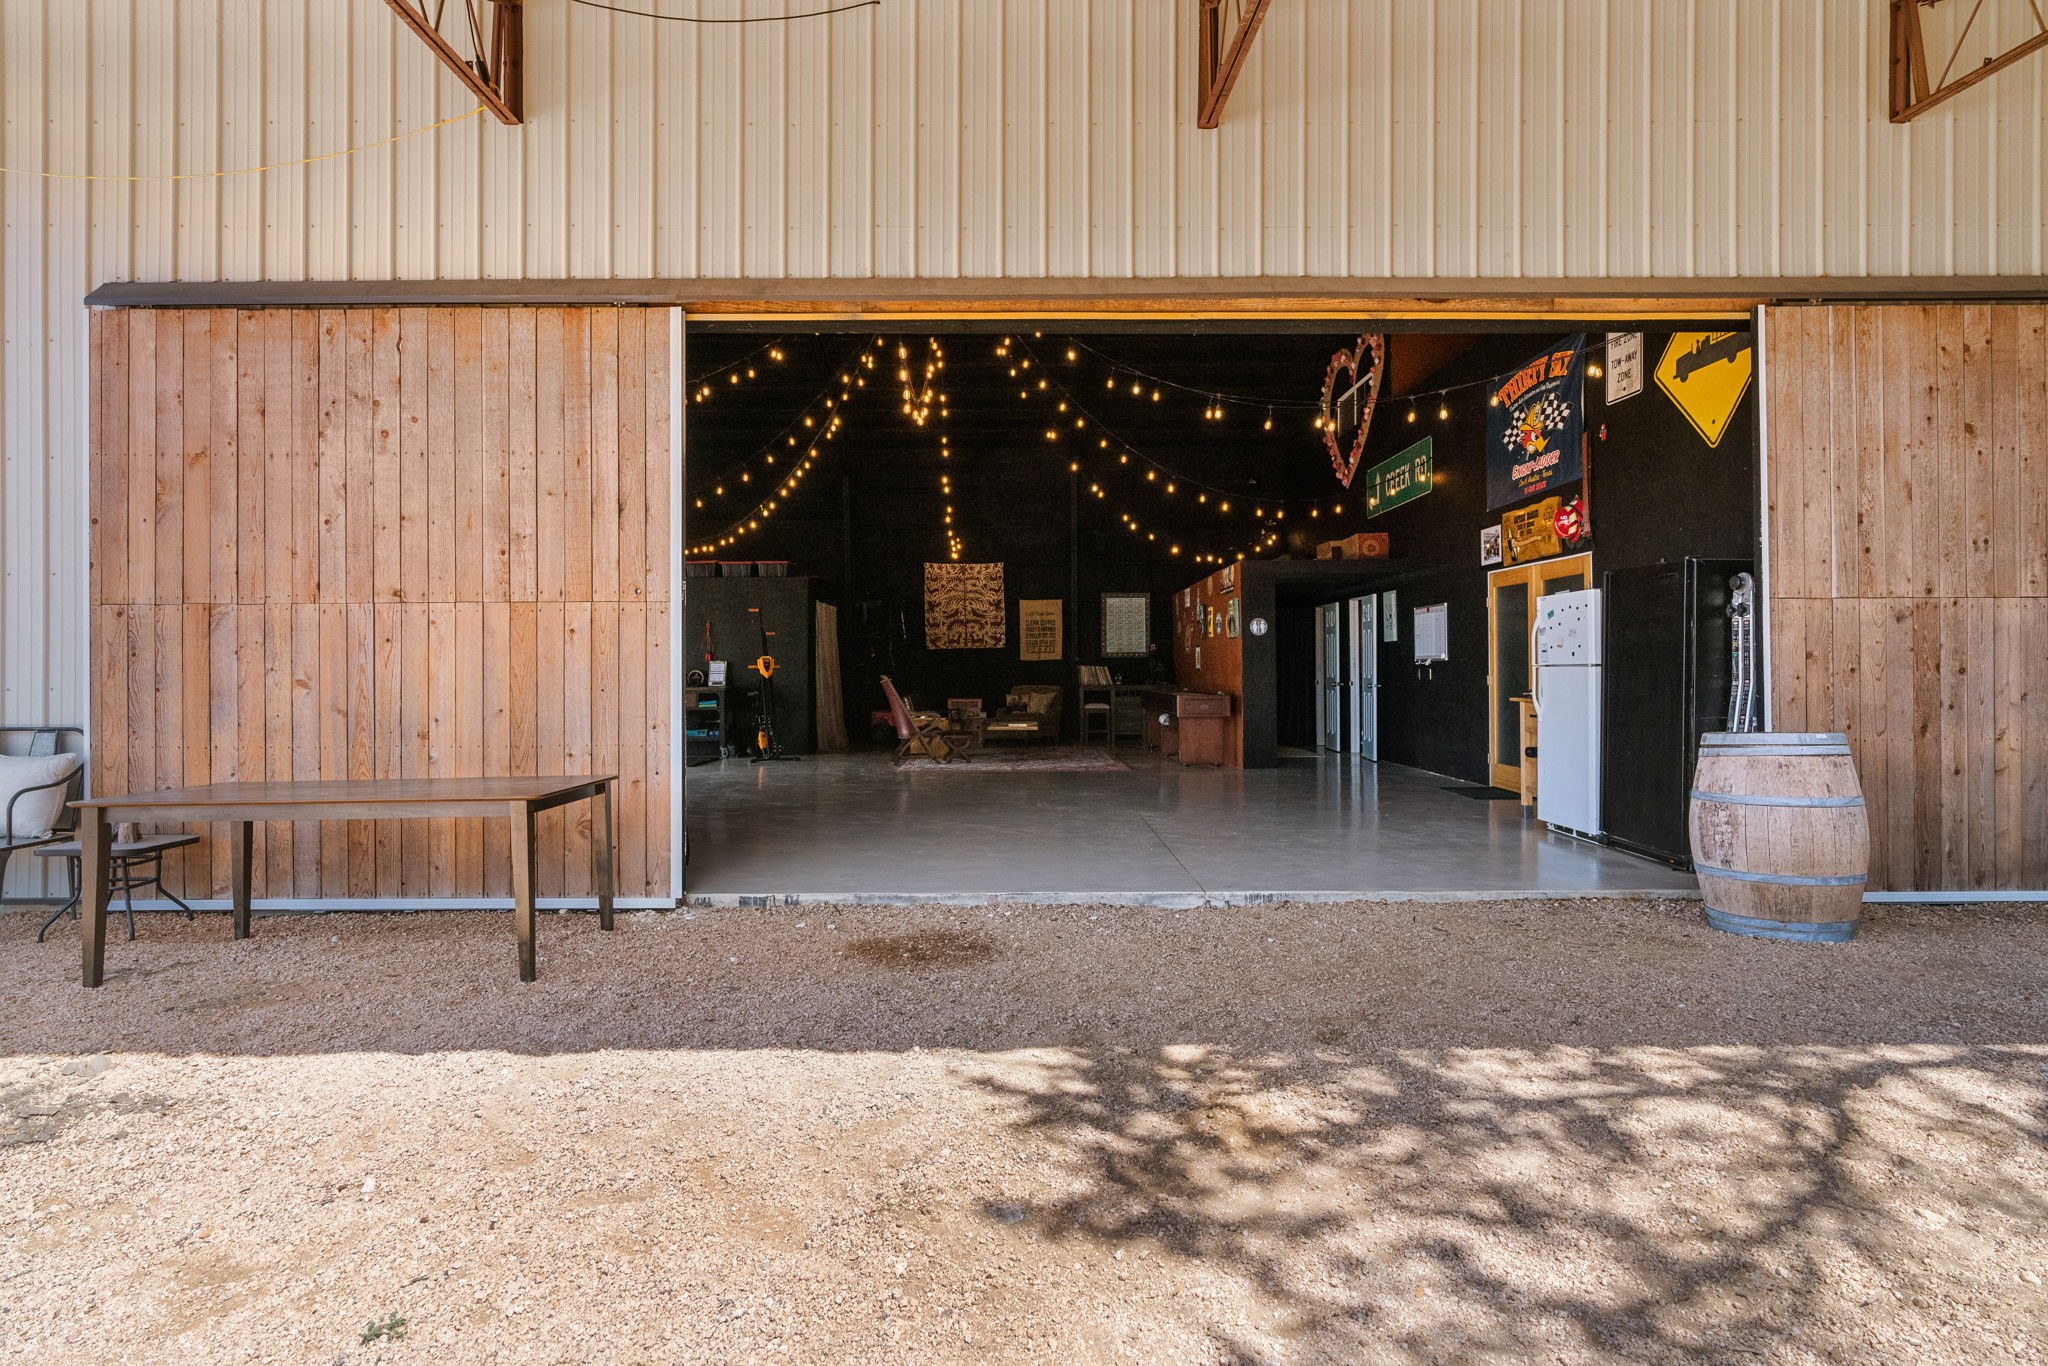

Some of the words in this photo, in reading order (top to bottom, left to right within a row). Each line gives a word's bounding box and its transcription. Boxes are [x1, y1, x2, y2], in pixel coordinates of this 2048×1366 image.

[1611, 350, 1638, 370] TOW-AWAY
[1498, 355, 1549, 409] THIRTY
[1548, 350, 1575, 378] SIX
[1617, 368, 1632, 383] ZONE
[1385, 462, 1411, 497] CREEK
